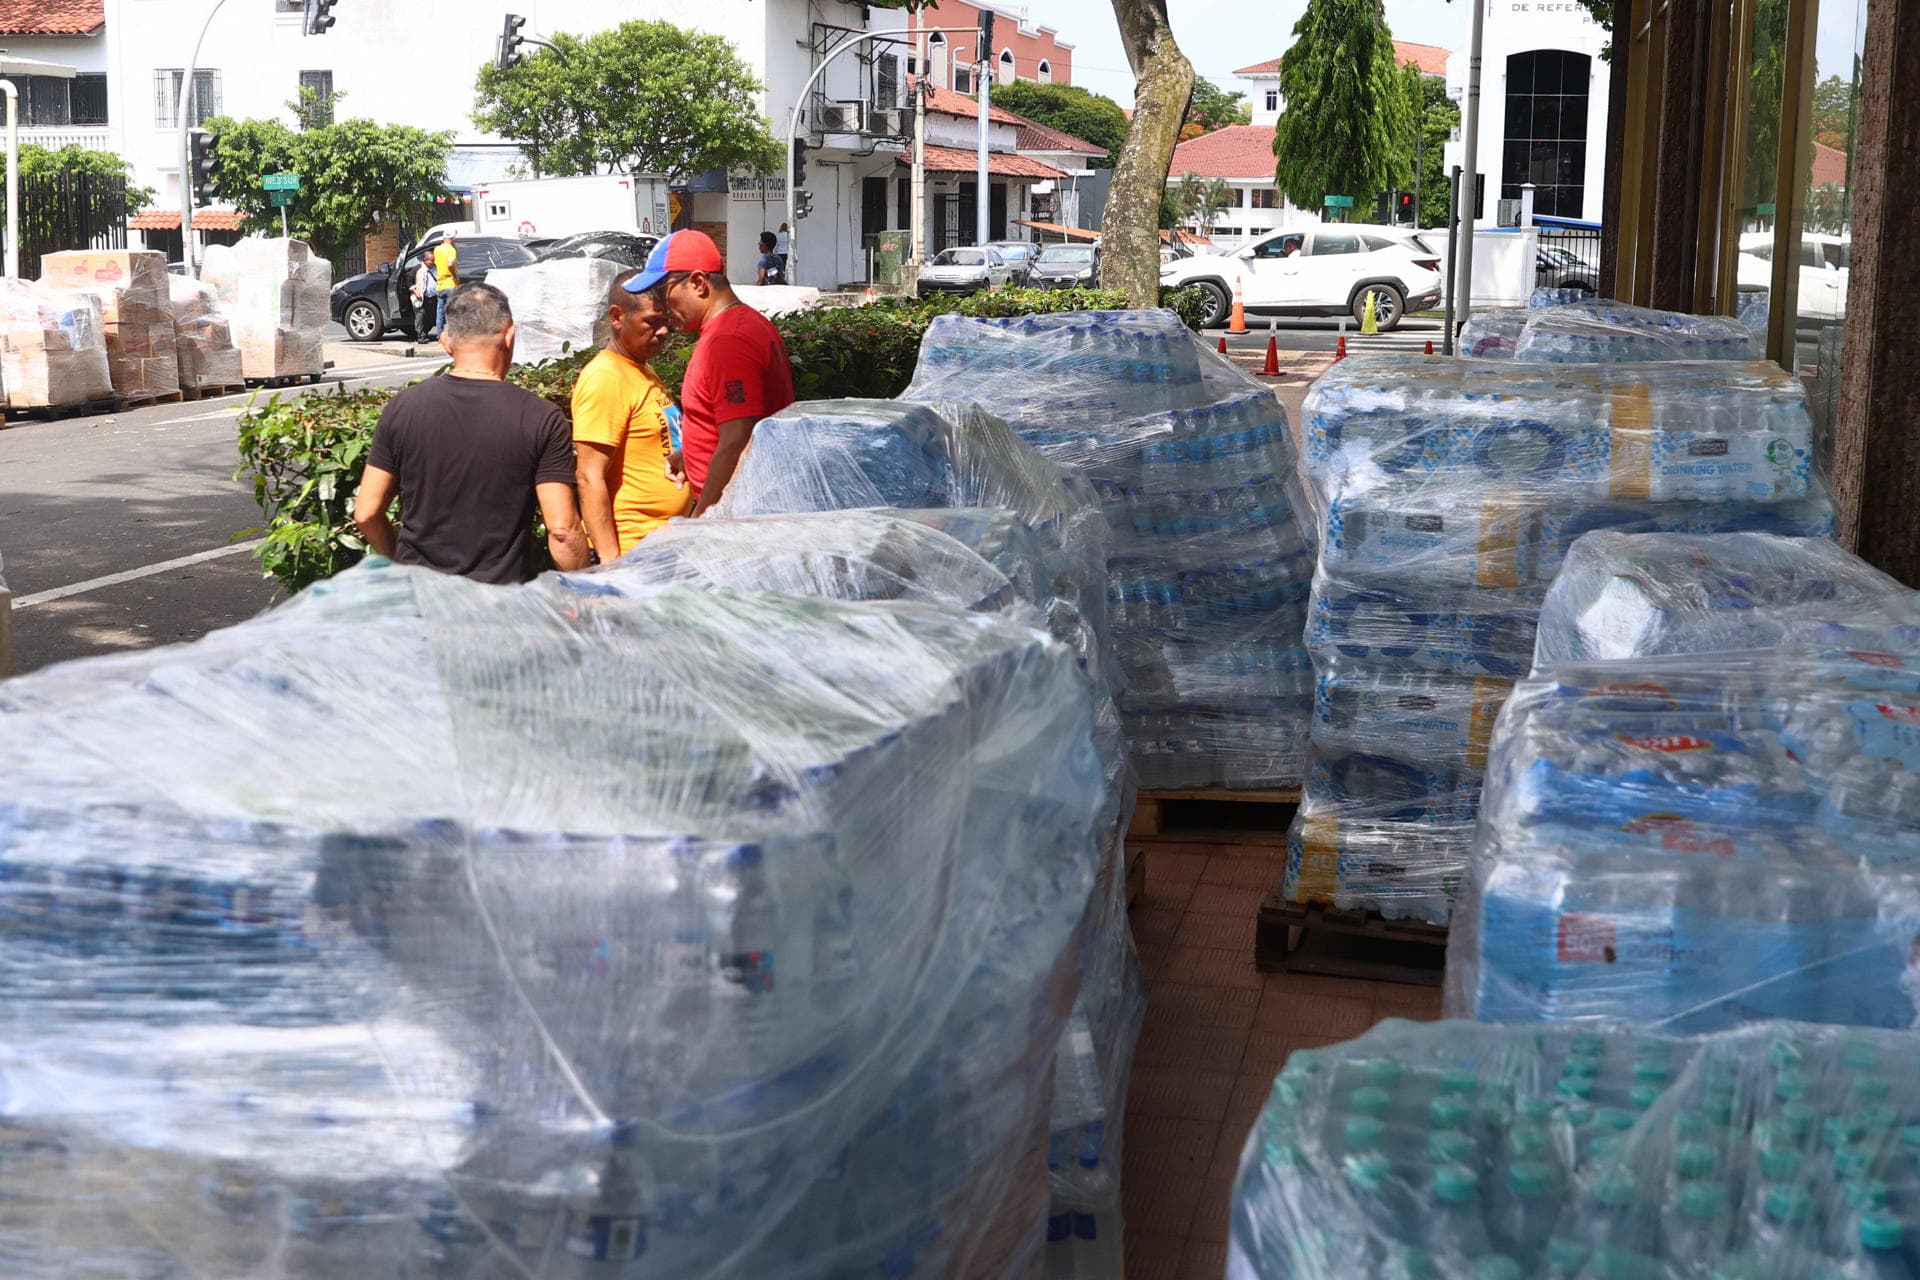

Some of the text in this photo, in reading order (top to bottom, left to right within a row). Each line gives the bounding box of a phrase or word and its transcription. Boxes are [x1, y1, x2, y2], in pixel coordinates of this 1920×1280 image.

[1511, 3, 1529, 12] DE
[283, 175, 298, 185] SUR
[1661, 462, 1753, 476] DRINKING WATER
